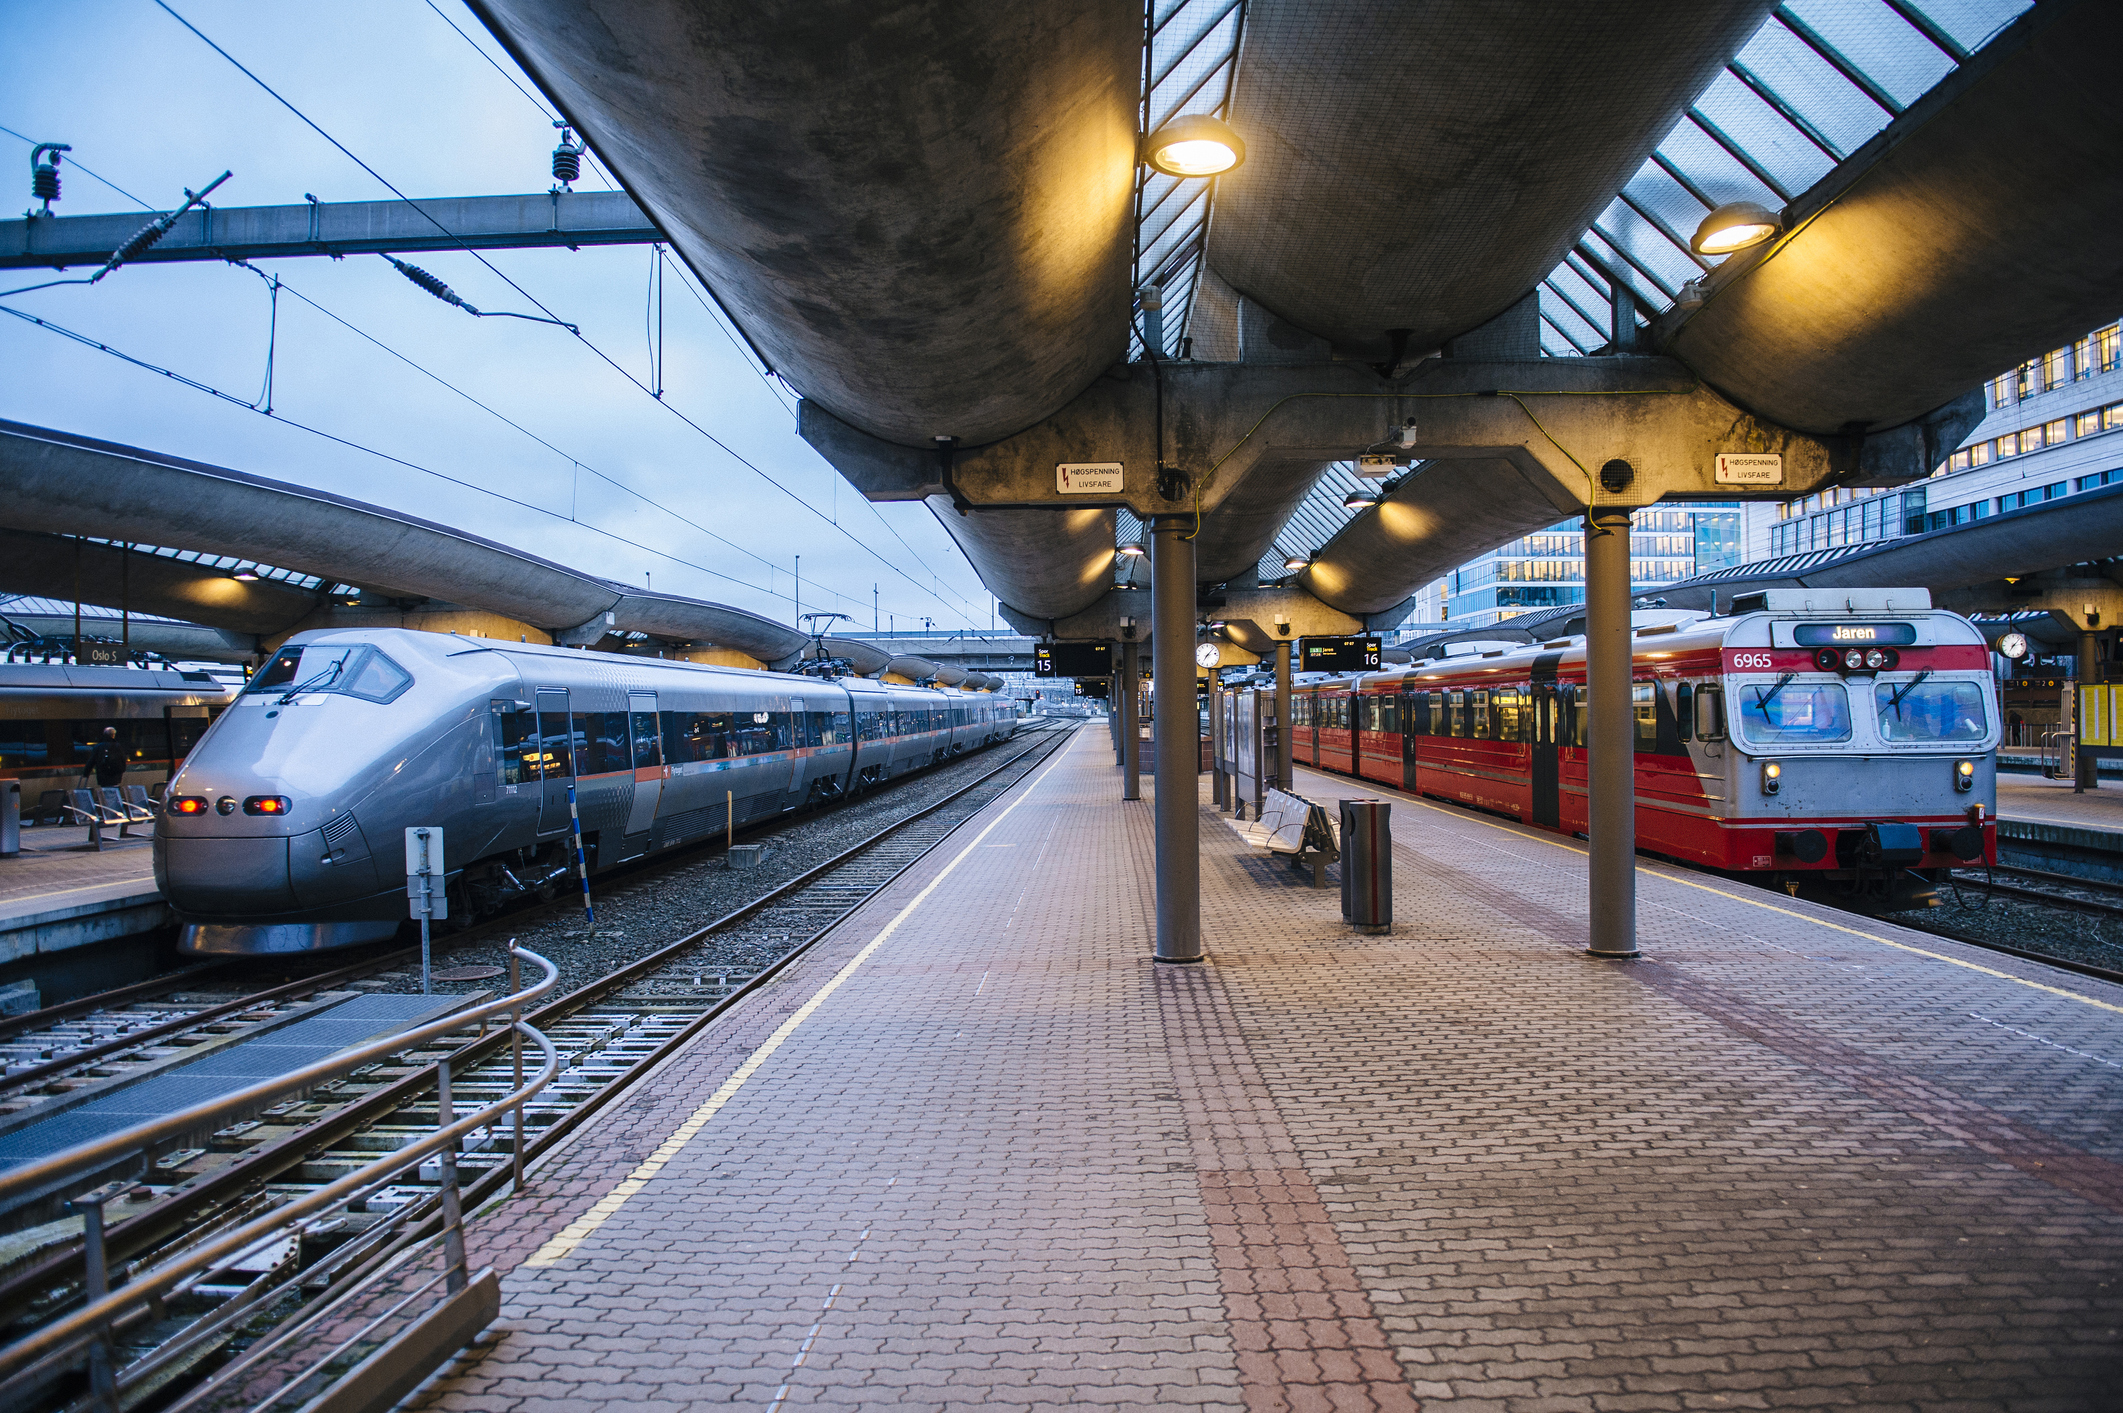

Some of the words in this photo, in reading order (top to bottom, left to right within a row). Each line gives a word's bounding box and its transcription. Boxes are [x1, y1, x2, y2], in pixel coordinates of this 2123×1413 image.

[1729, 458, 1779, 467] HØGSPENNING
[1070, 467, 1120, 476] HØGSPENNING
[1737, 471, 1771, 479] LIVSFARE
[1078, 480, 1112, 488] LIVSFARE
[1832, 626, 1876, 640] Jaren
[91, 649, 110, 661] Oslo
[112, 650, 117, 662] S
[1364, 653, 1379, 665] 16
[1733, 653, 1772, 668] 6965
[1037, 660, 1051, 672] 15
